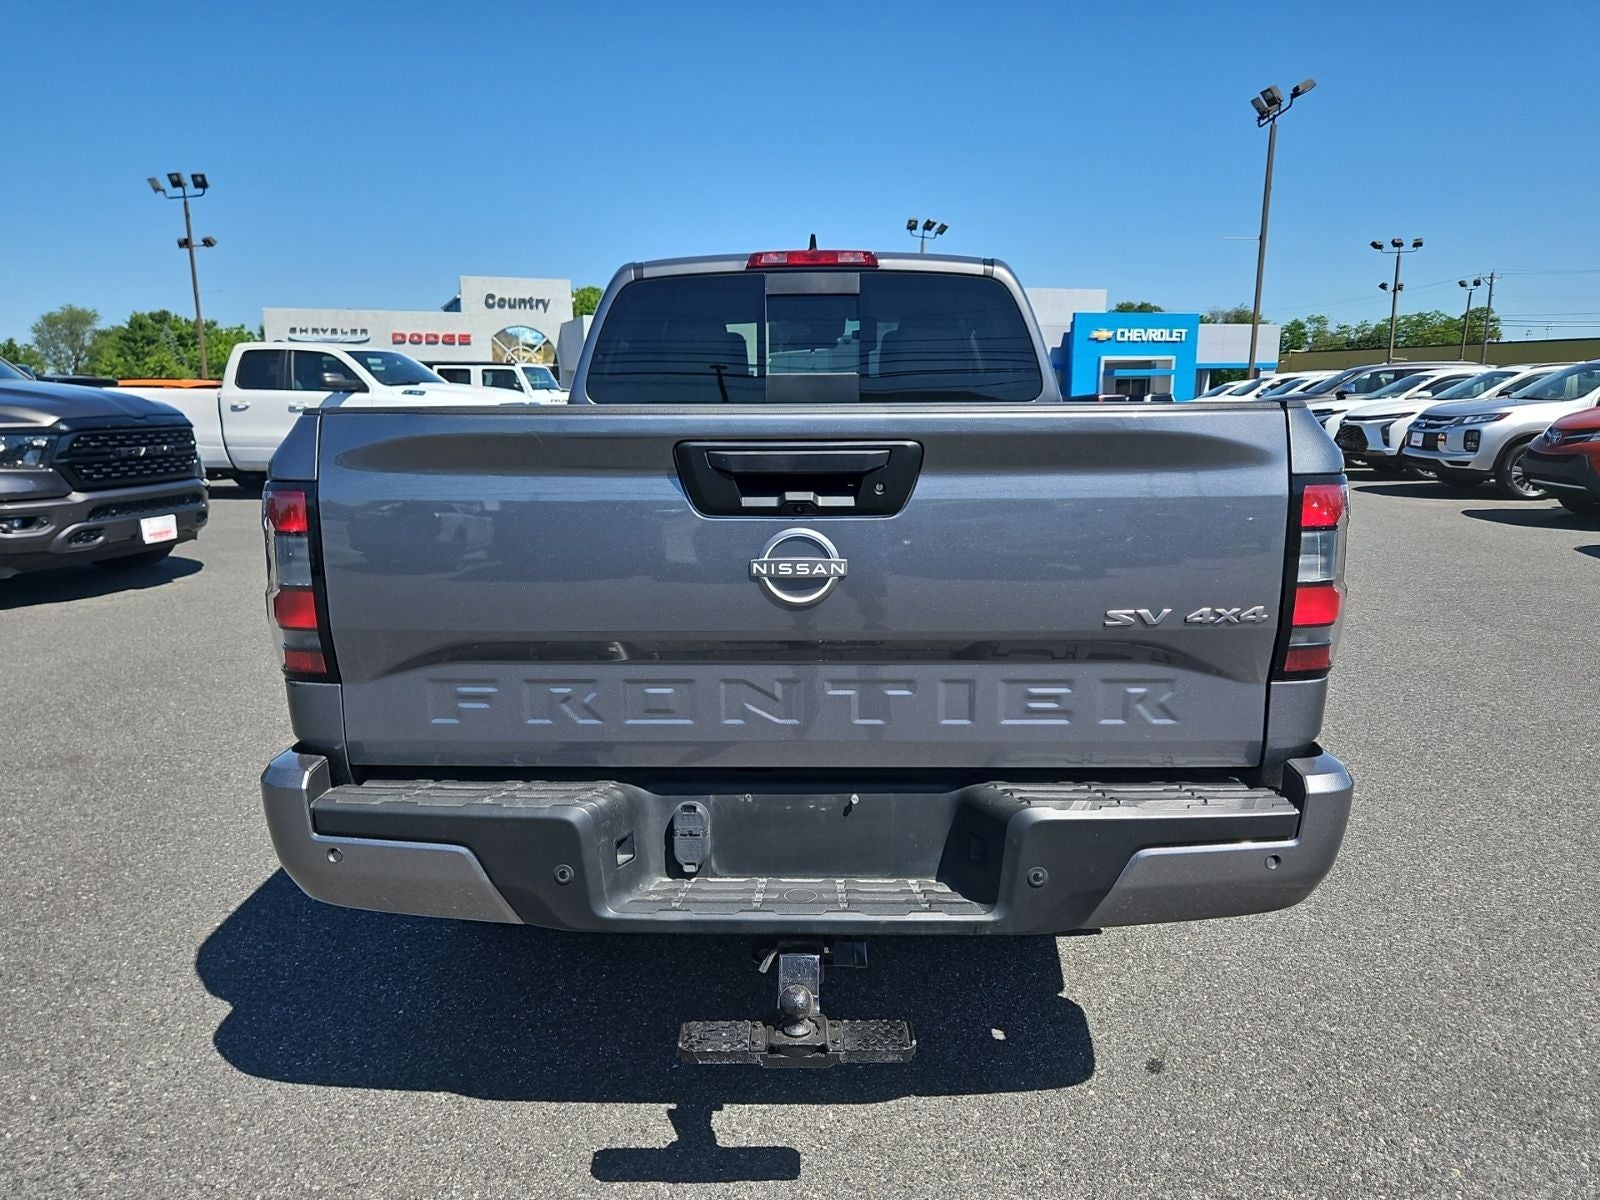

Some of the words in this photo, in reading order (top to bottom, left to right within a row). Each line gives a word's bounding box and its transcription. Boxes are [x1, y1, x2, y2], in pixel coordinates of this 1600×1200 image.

[484, 293, 550, 313] Country
[289, 327, 369, 336] CHRYSLER
[1116, 328, 1188, 342] CHEVROLET
[392, 333, 472, 346] DODGE
[753, 563, 845, 575] NISSAN
[1104, 608, 1172, 627] SV
[427, 678, 1179, 726] FRONTIER
